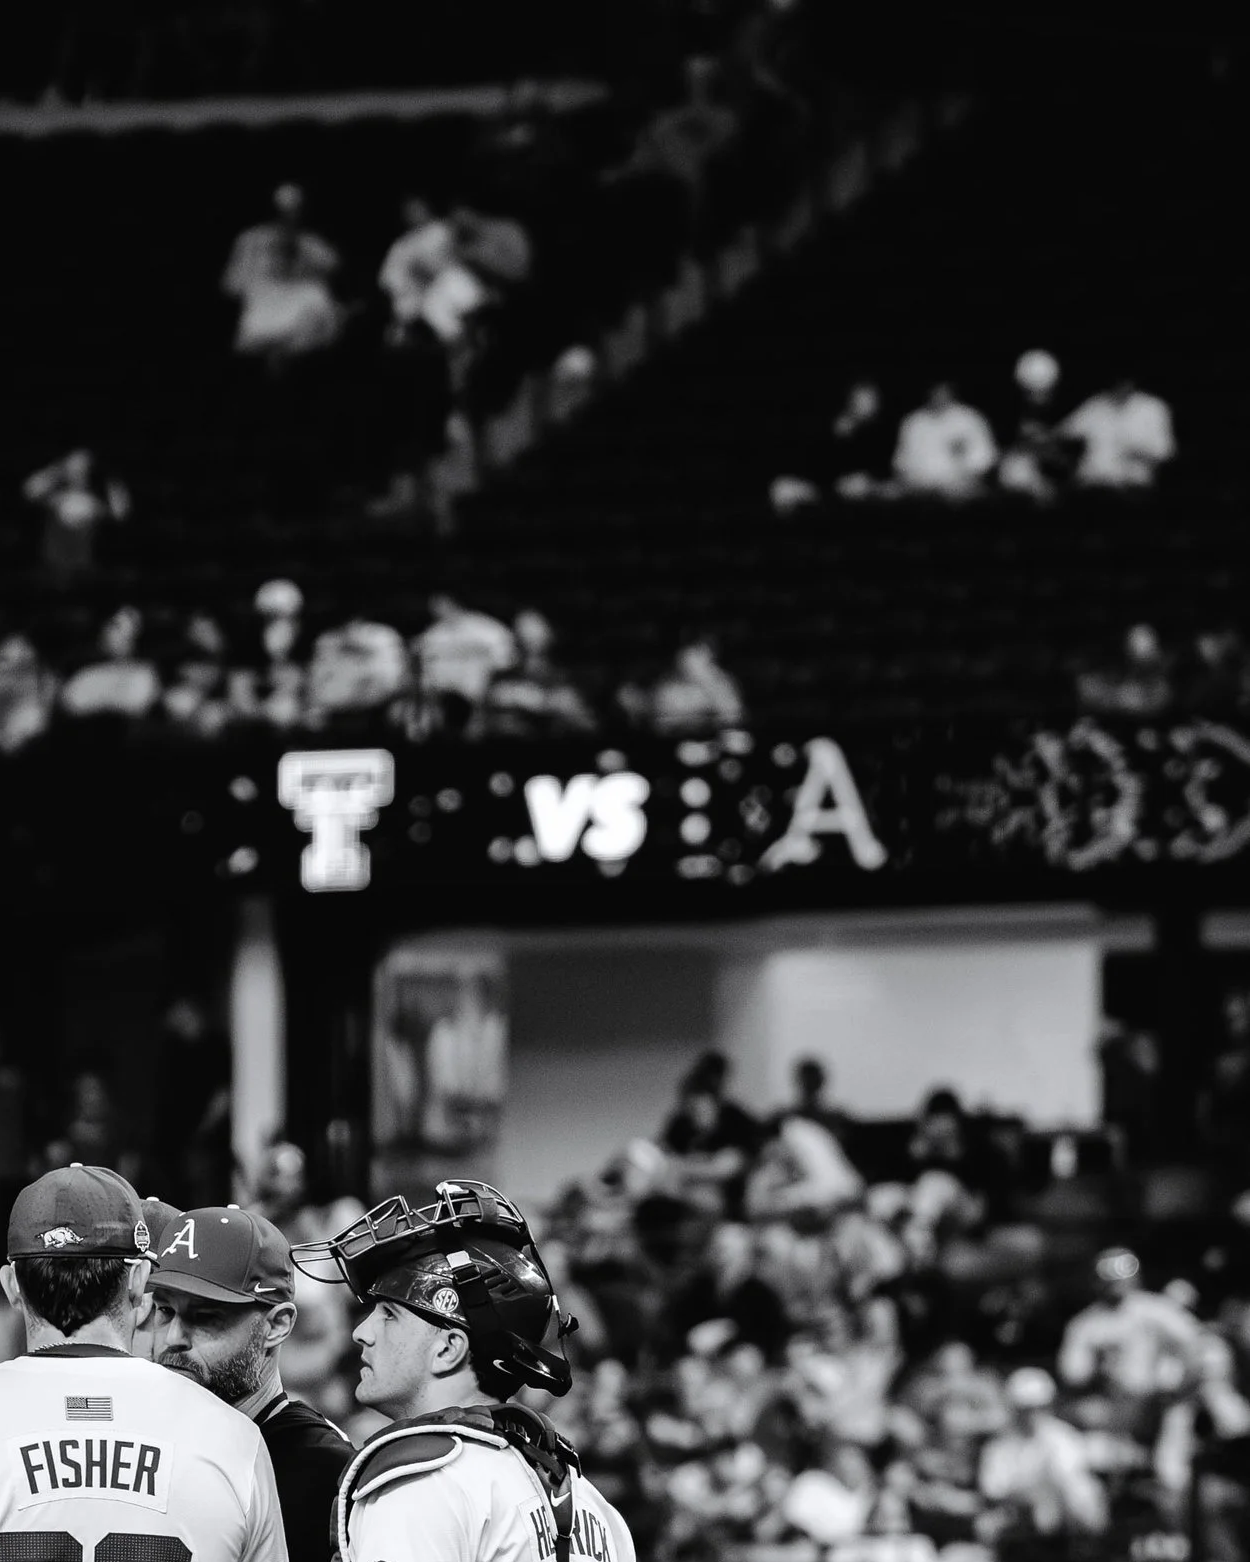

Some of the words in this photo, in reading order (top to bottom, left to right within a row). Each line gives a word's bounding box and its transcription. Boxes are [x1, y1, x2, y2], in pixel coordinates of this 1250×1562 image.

[758, 737, 886, 869] A
[161, 1218, 200, 1259] A
[19, 1439, 160, 1496] FISHER
